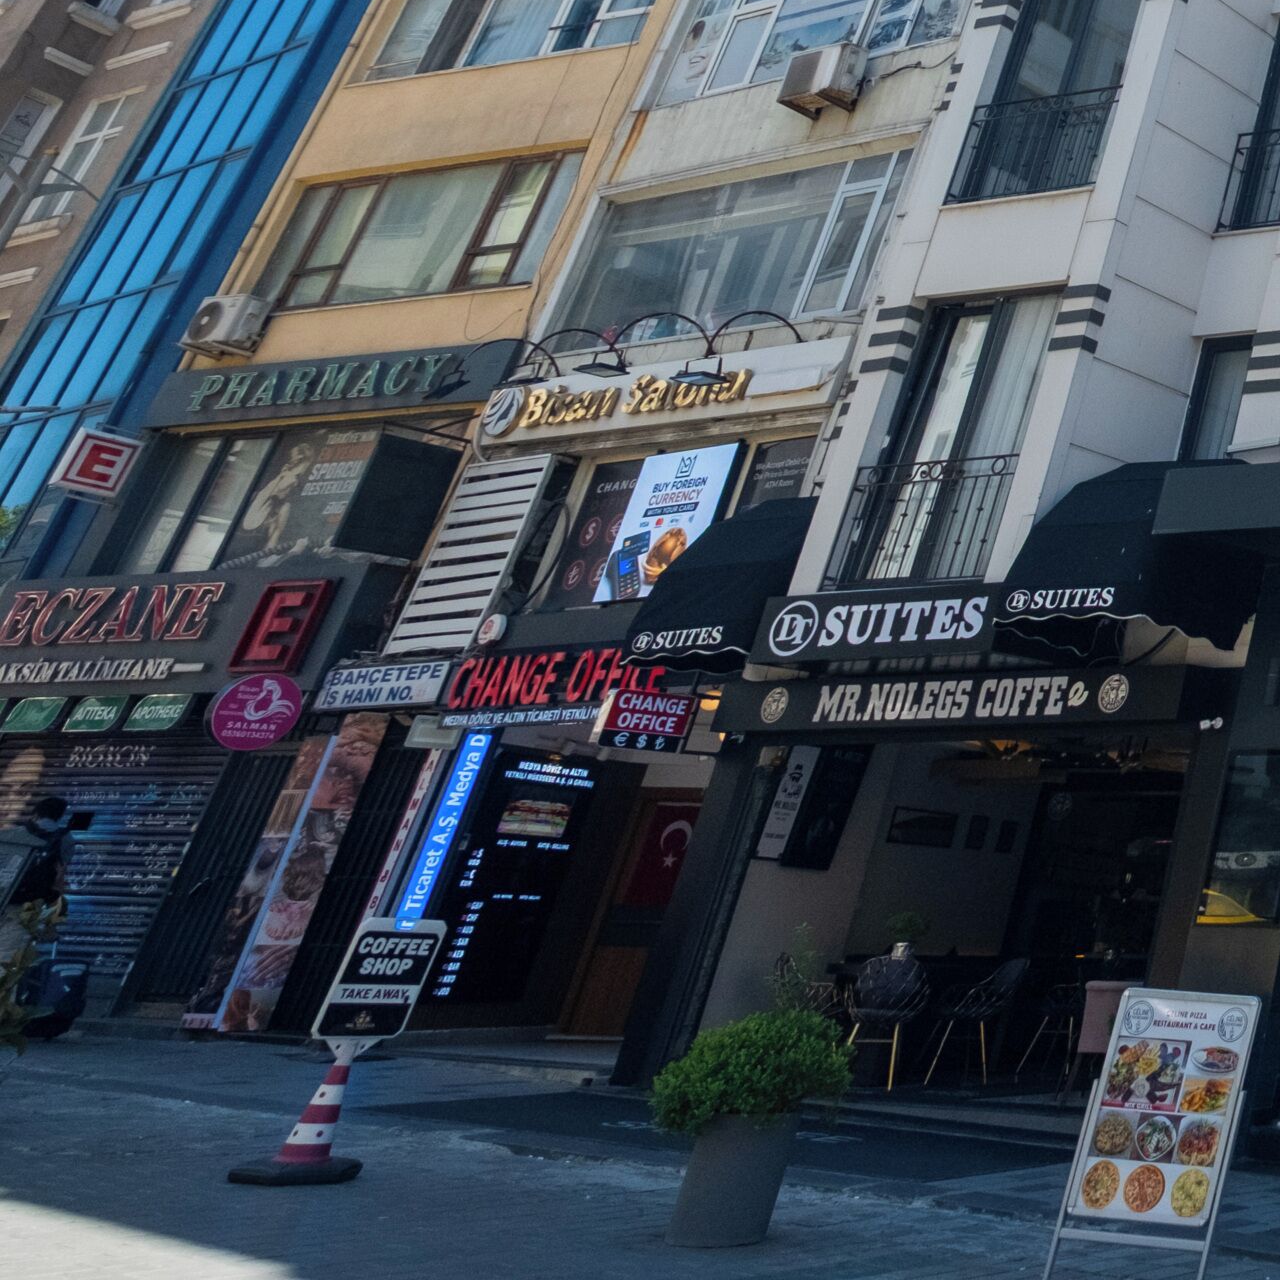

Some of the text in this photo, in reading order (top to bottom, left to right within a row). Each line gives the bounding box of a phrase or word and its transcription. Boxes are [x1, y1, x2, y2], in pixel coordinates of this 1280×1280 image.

[186, 353, 453, 412] PHARMACY
[597, 478, 637, 494] CHANG
[652, 477, 708, 493] BUY FOREIGN
[648, 488, 703, 506] CURRENCY
[1030, 587, 1115, 610] SUITES
[0, 582, 226, 646] ECZANE
[817, 596, 990, 647] SUITES
[244, 591, 306, 661] E
[651, 626, 723, 650] SUITES
[0, 655, 174, 683] AKSİM TALİMHANE
[331, 663, 443, 686] BAHÇETEPE
[448, 651, 567, 710] CHANGE
[341, 687, 383, 704] HANI
[618, 692, 689, 716] CHANGE
[132, 704, 184, 719] APOTHEKE
[616, 711, 676, 733] OFFICE
[226, 721, 277, 730] SALMAN
[405, 849, 443, 911] Ticaret
[447, 755, 482, 807] Medya
[358, 937, 434, 955] COFFEE
[359, 958, 413, 975] SHOP
[340, 988, 409, 1000] TAKE AWAY
[1153, 1020, 1192, 1030] RESTAURANT
